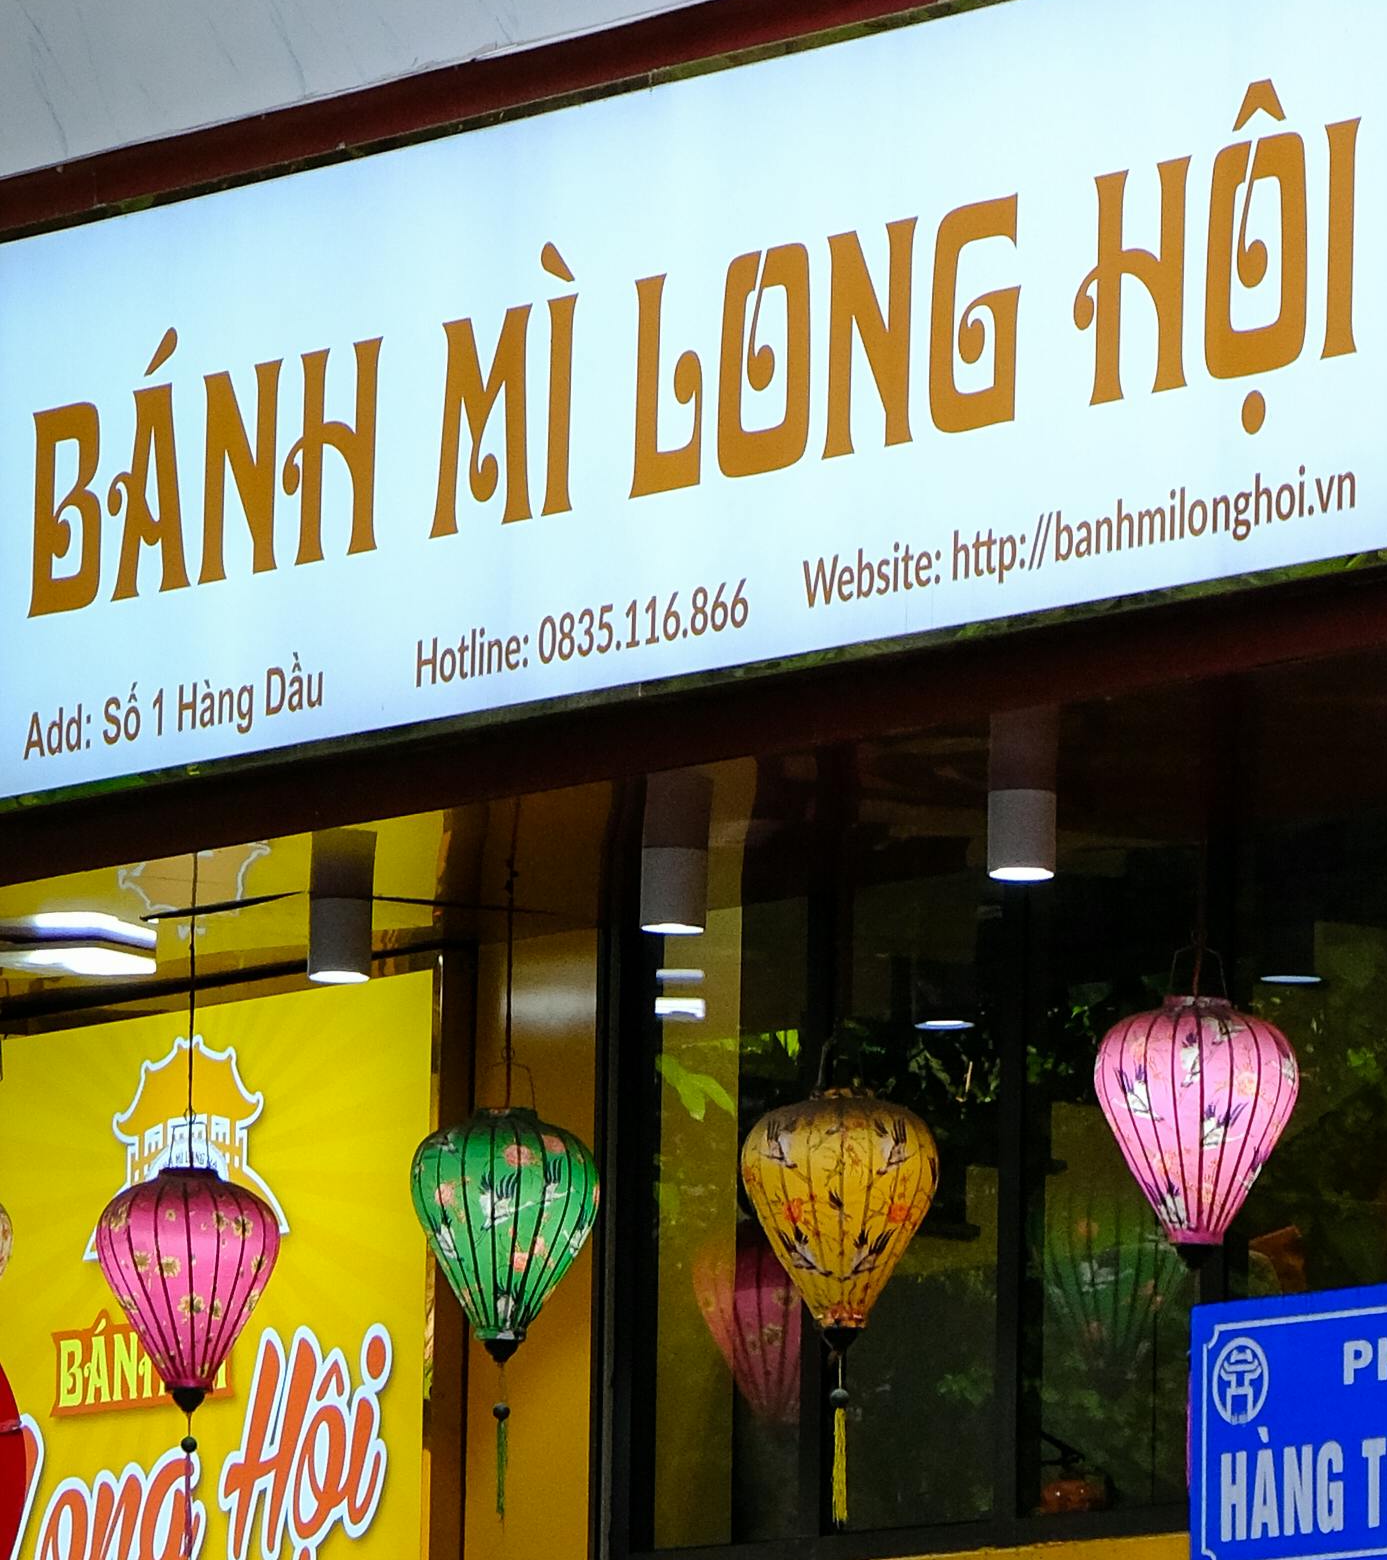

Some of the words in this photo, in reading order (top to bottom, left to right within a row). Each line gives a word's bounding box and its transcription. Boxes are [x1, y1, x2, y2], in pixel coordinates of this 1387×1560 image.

[28, 328, 384, 618] BÁNH
[430, 242, 579, 538] MÌ
[630, 194, 1020, 499] LONG
[1073, 79, 1361, 435] HỘI
[804, 547, 942, 608] Website:
[951, 465, 1358, 583] http://banhmilonghoi.vn
[415, 633, 530, 688] Hotline:
[539, 578, 750, 666] 0835.116.866
[23, 704, 92, 759] Add:
[103, 683, 141, 745] Số
[151, 689, 166, 736] 1
[177, 676, 256, 735] Hàng
[265, 652, 325, 717] Dầu
[1220, 1427, 1344, 1543] HÀNG
